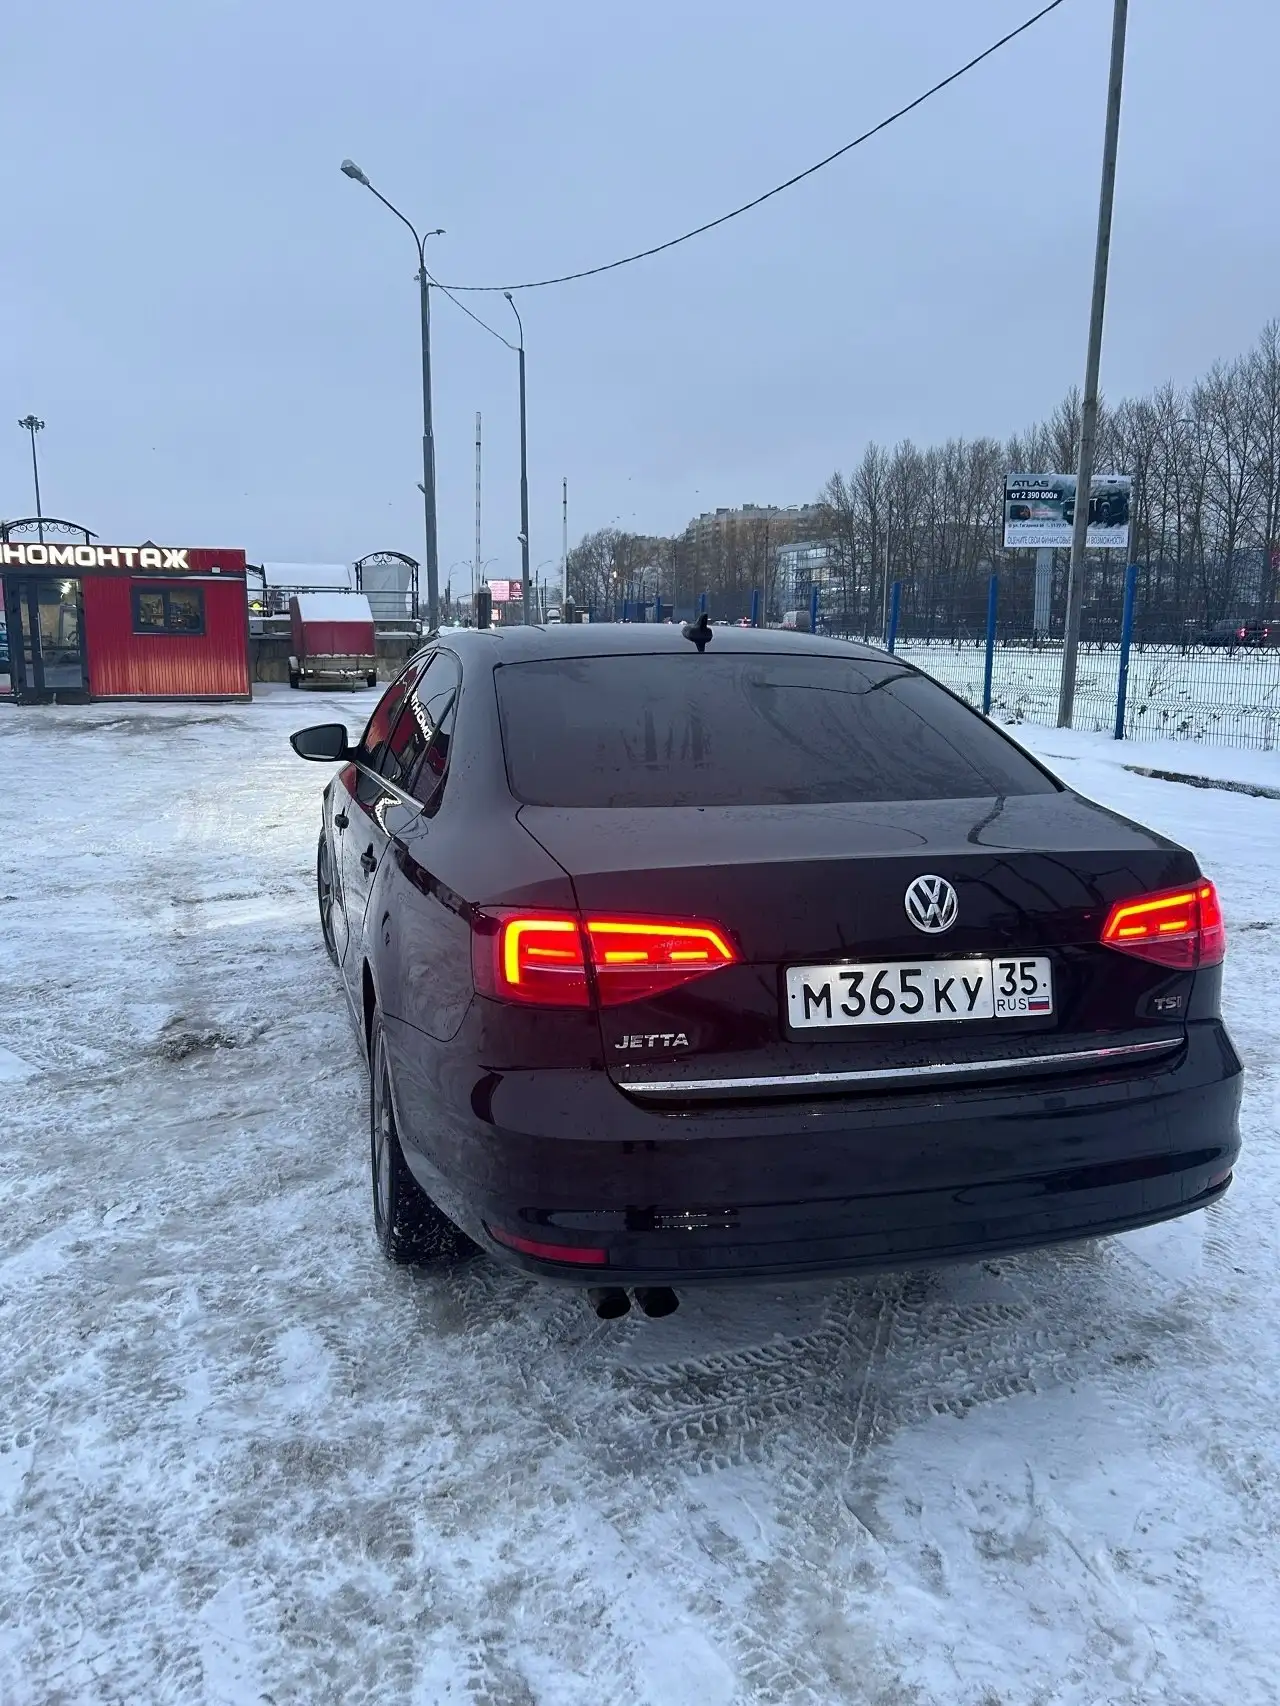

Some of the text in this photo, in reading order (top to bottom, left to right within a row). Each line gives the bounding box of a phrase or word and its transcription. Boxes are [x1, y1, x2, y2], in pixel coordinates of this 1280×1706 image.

[1012, 480, 1049, 488] ATLAS
[1021, 491, 1026, 499] 2
[1026, 491, 1040, 499] 390
[0, 544, 189, 568] НОМОНТАЖ
[999, 961, 1038, 996] 35
[997, 998, 1027, 1011] RUS
[1154, 996, 1181, 1010] TSI
[614, 1033, 689, 1049] JETTA
